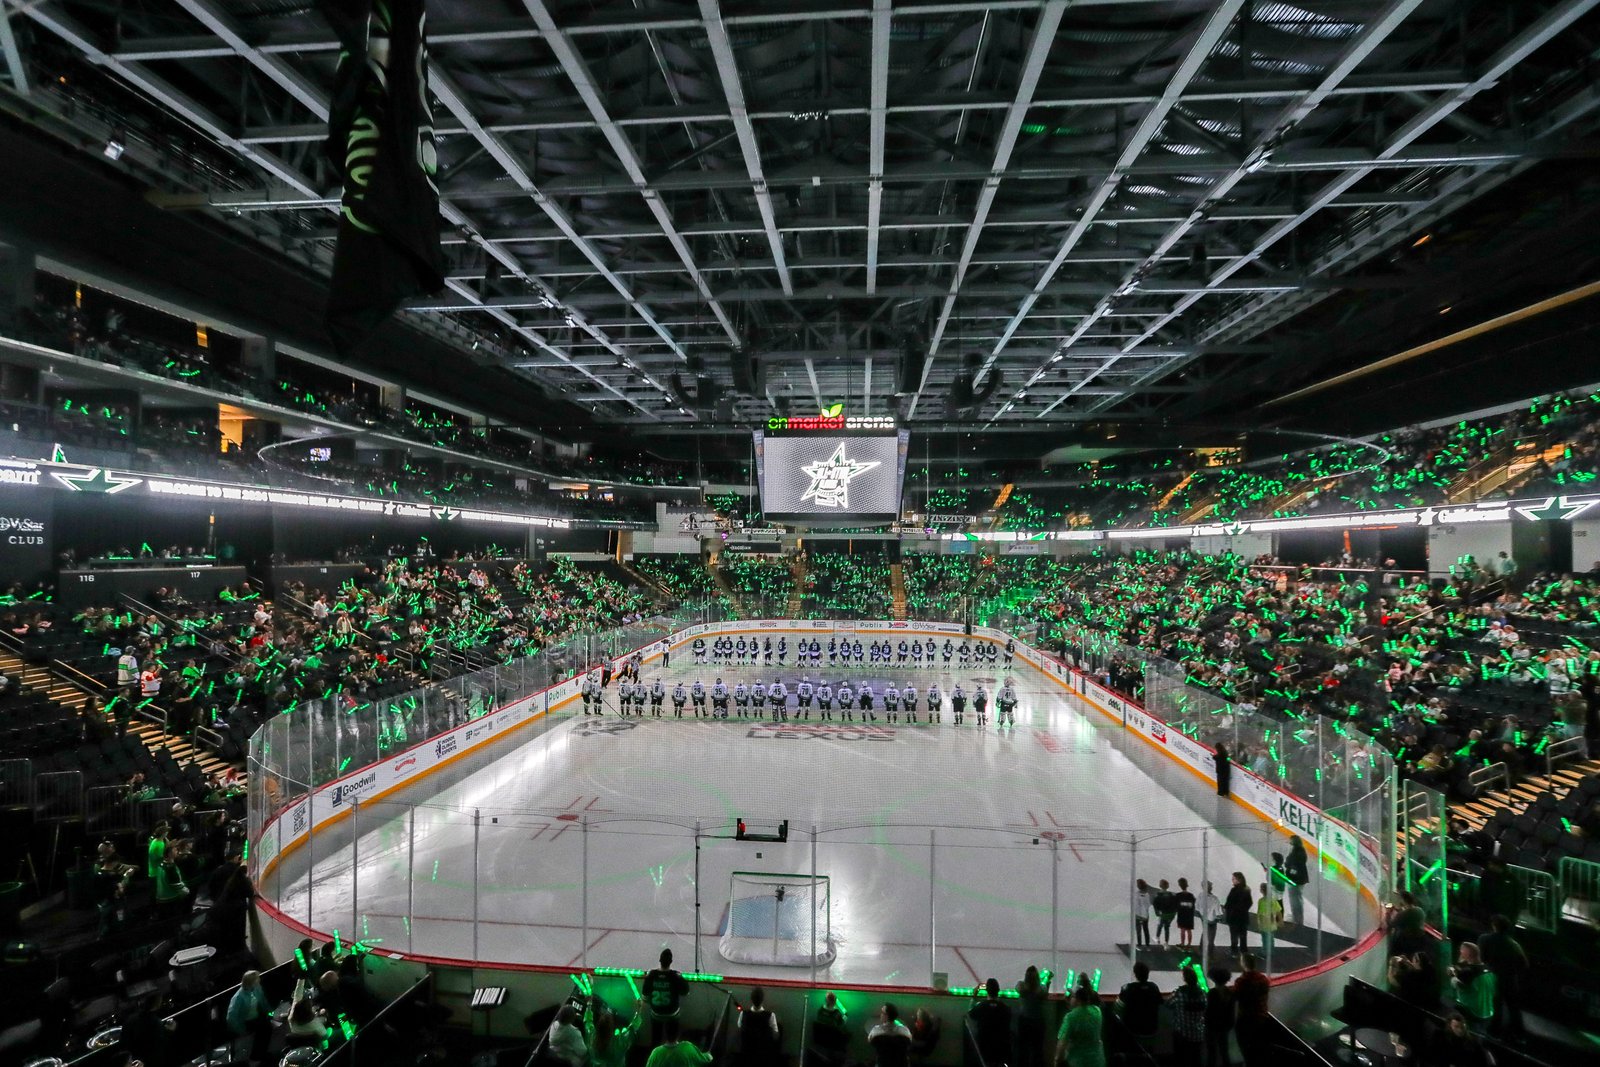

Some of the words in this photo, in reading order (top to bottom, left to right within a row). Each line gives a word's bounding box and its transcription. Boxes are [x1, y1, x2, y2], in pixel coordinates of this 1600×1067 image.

[768, 414, 844, 429] onmarket
[846, 416, 894, 429] arena
[10, 517, 44, 531] VyStar
[8, 536, 44, 545] CLUB
[79, 574, 95, 582] 116
[549, 689, 566, 702] Publix
[715, 687, 722, 695] 35
[889, 693, 896, 701] 16
[441, 735, 455, 745] INDOOR
[746, 731, 895, 742] LEXUS
[441, 745, 457, 756] EXPERTS
[342, 771, 376, 797] Goodwill
[293, 807, 306, 822] SOCIAL
[1280, 797, 1323, 841] KELLY
[293, 817, 304, 832] CLUB
